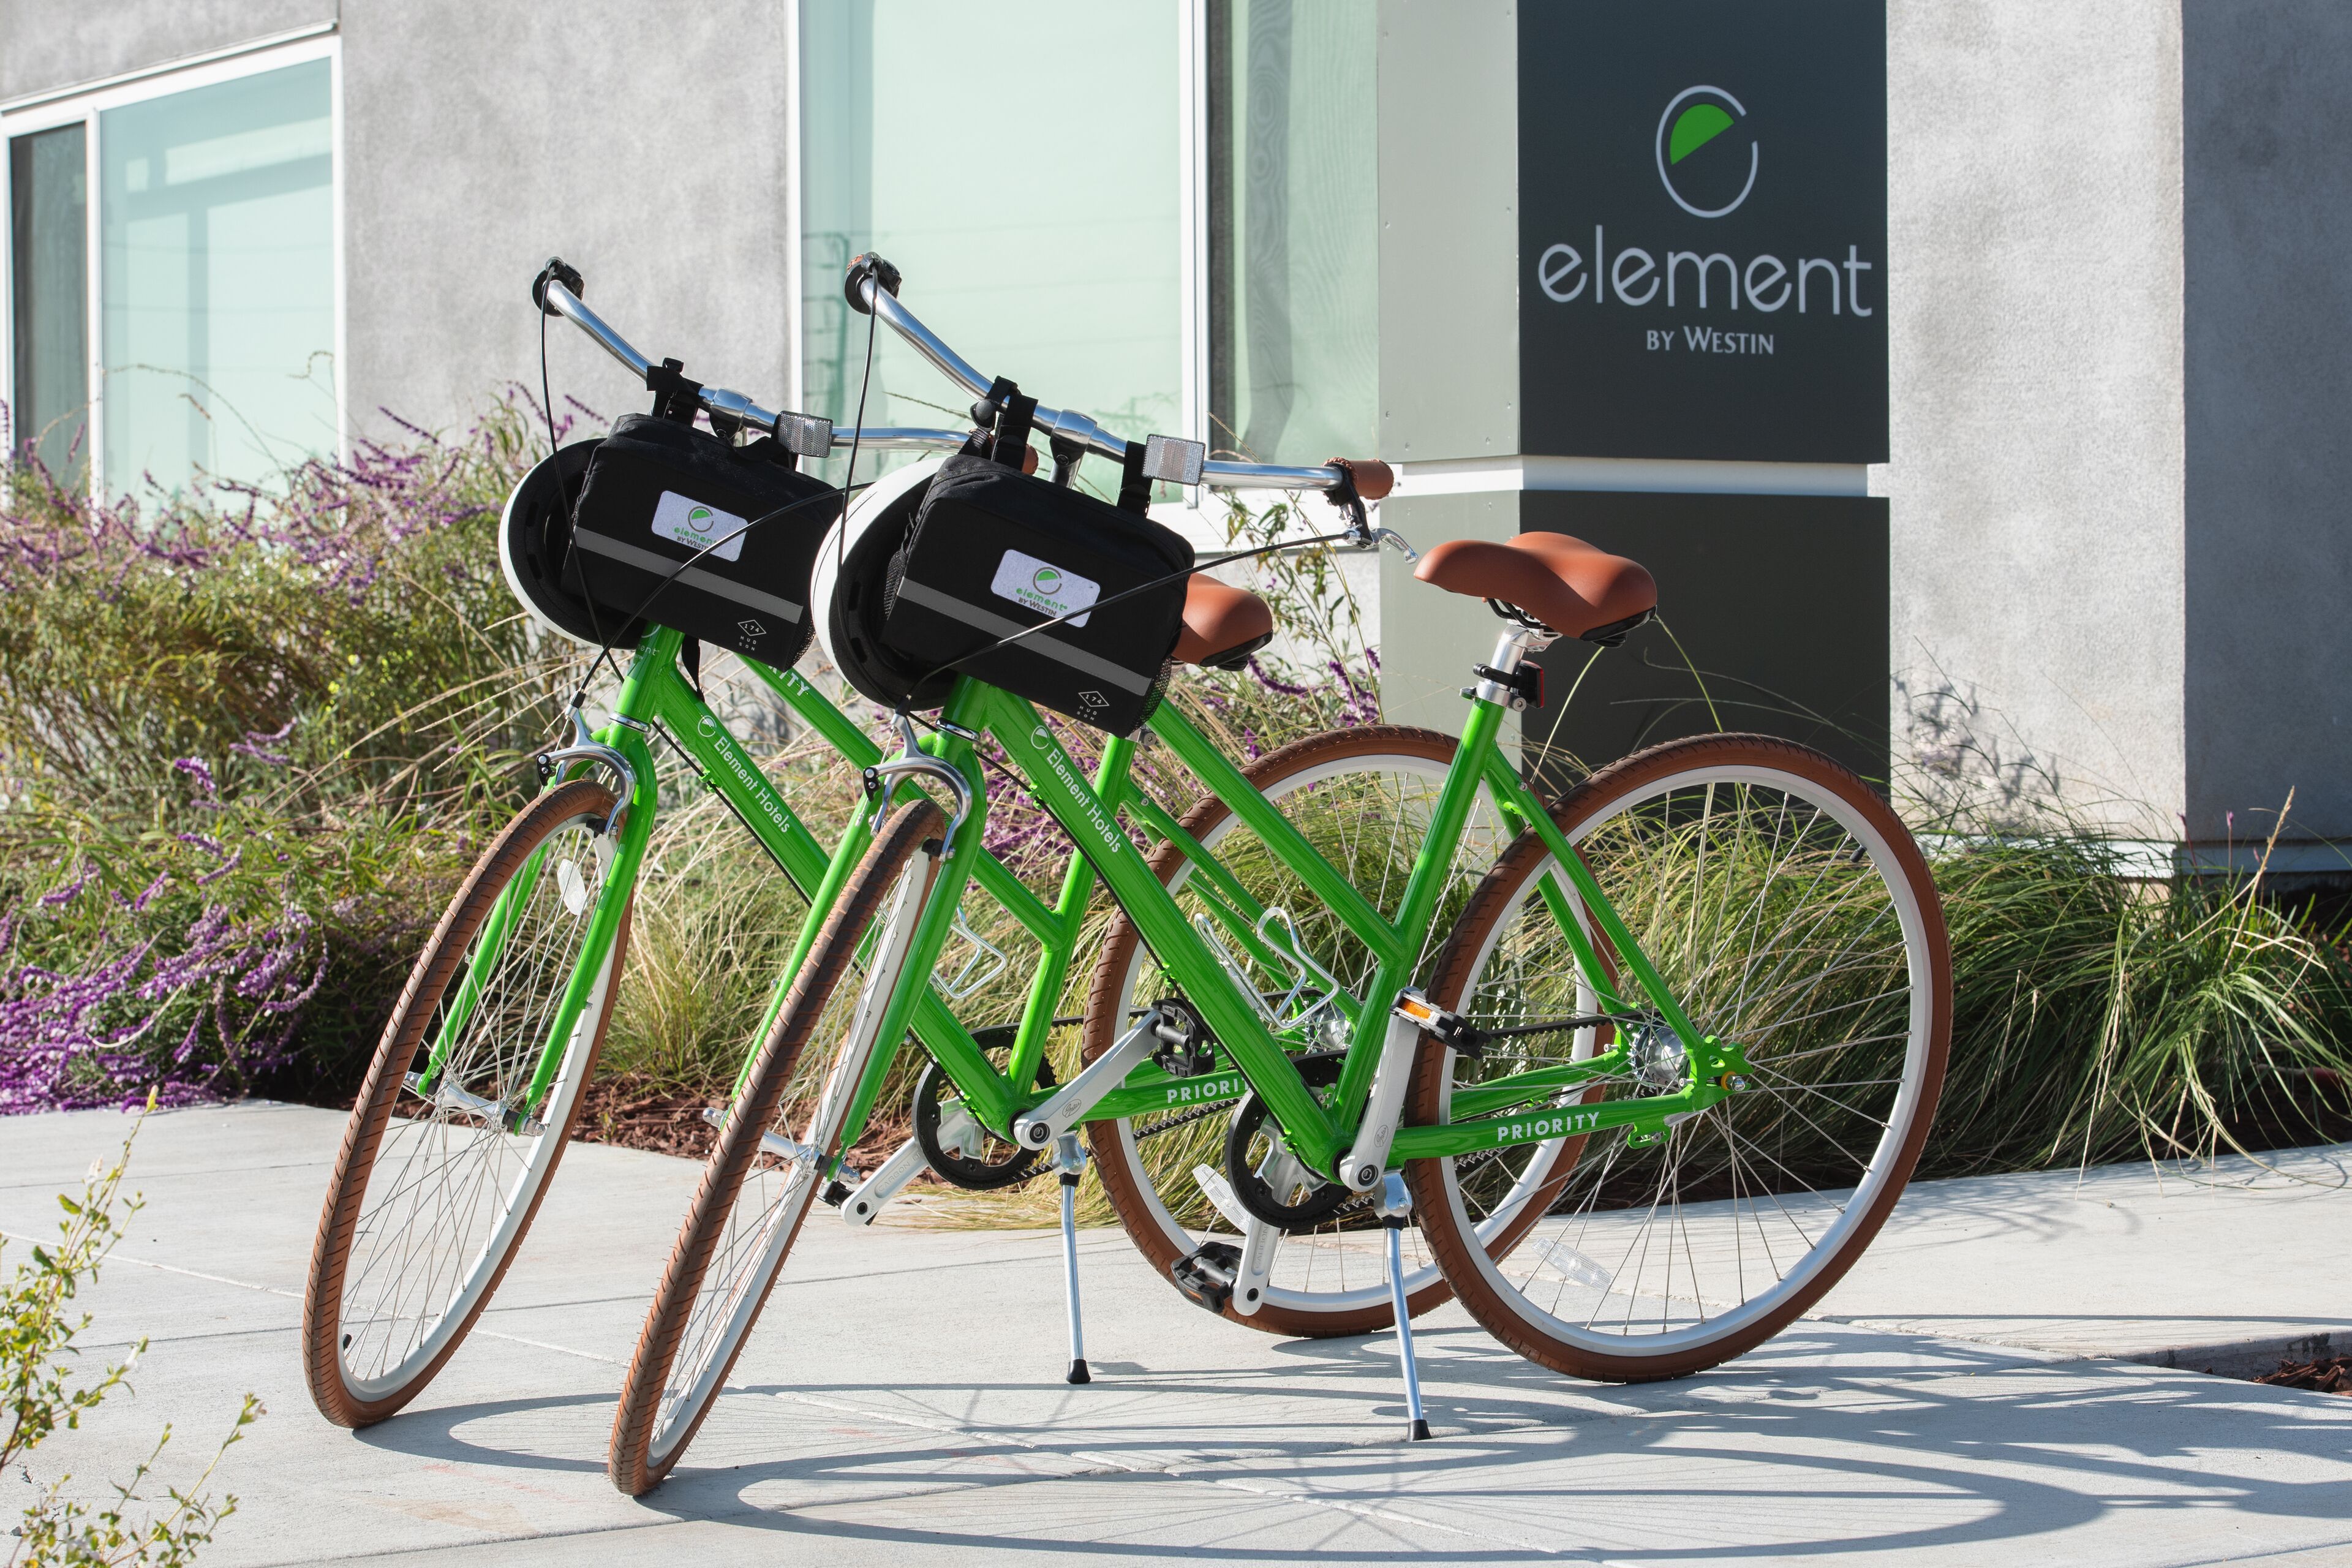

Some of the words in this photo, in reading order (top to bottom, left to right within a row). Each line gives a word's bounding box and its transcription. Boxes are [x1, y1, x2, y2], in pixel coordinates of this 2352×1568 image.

[1538, 224, 1872, 317] element
[1646, 330, 1675, 351] BY
[687, 538, 709, 550] WESTI
[744, 624, 760, 633] 174
[1085, 694, 1102, 704] 174
[714, 736, 759, 791] Element
[755, 786, 791, 834] Hotels
[1046, 747, 1091, 808] Element
[1086, 803, 1121, 853] Hotels
[1166, 1077, 1250, 1104] PRIORIT
[1497, 1111, 1600, 1142] PRIORITY
